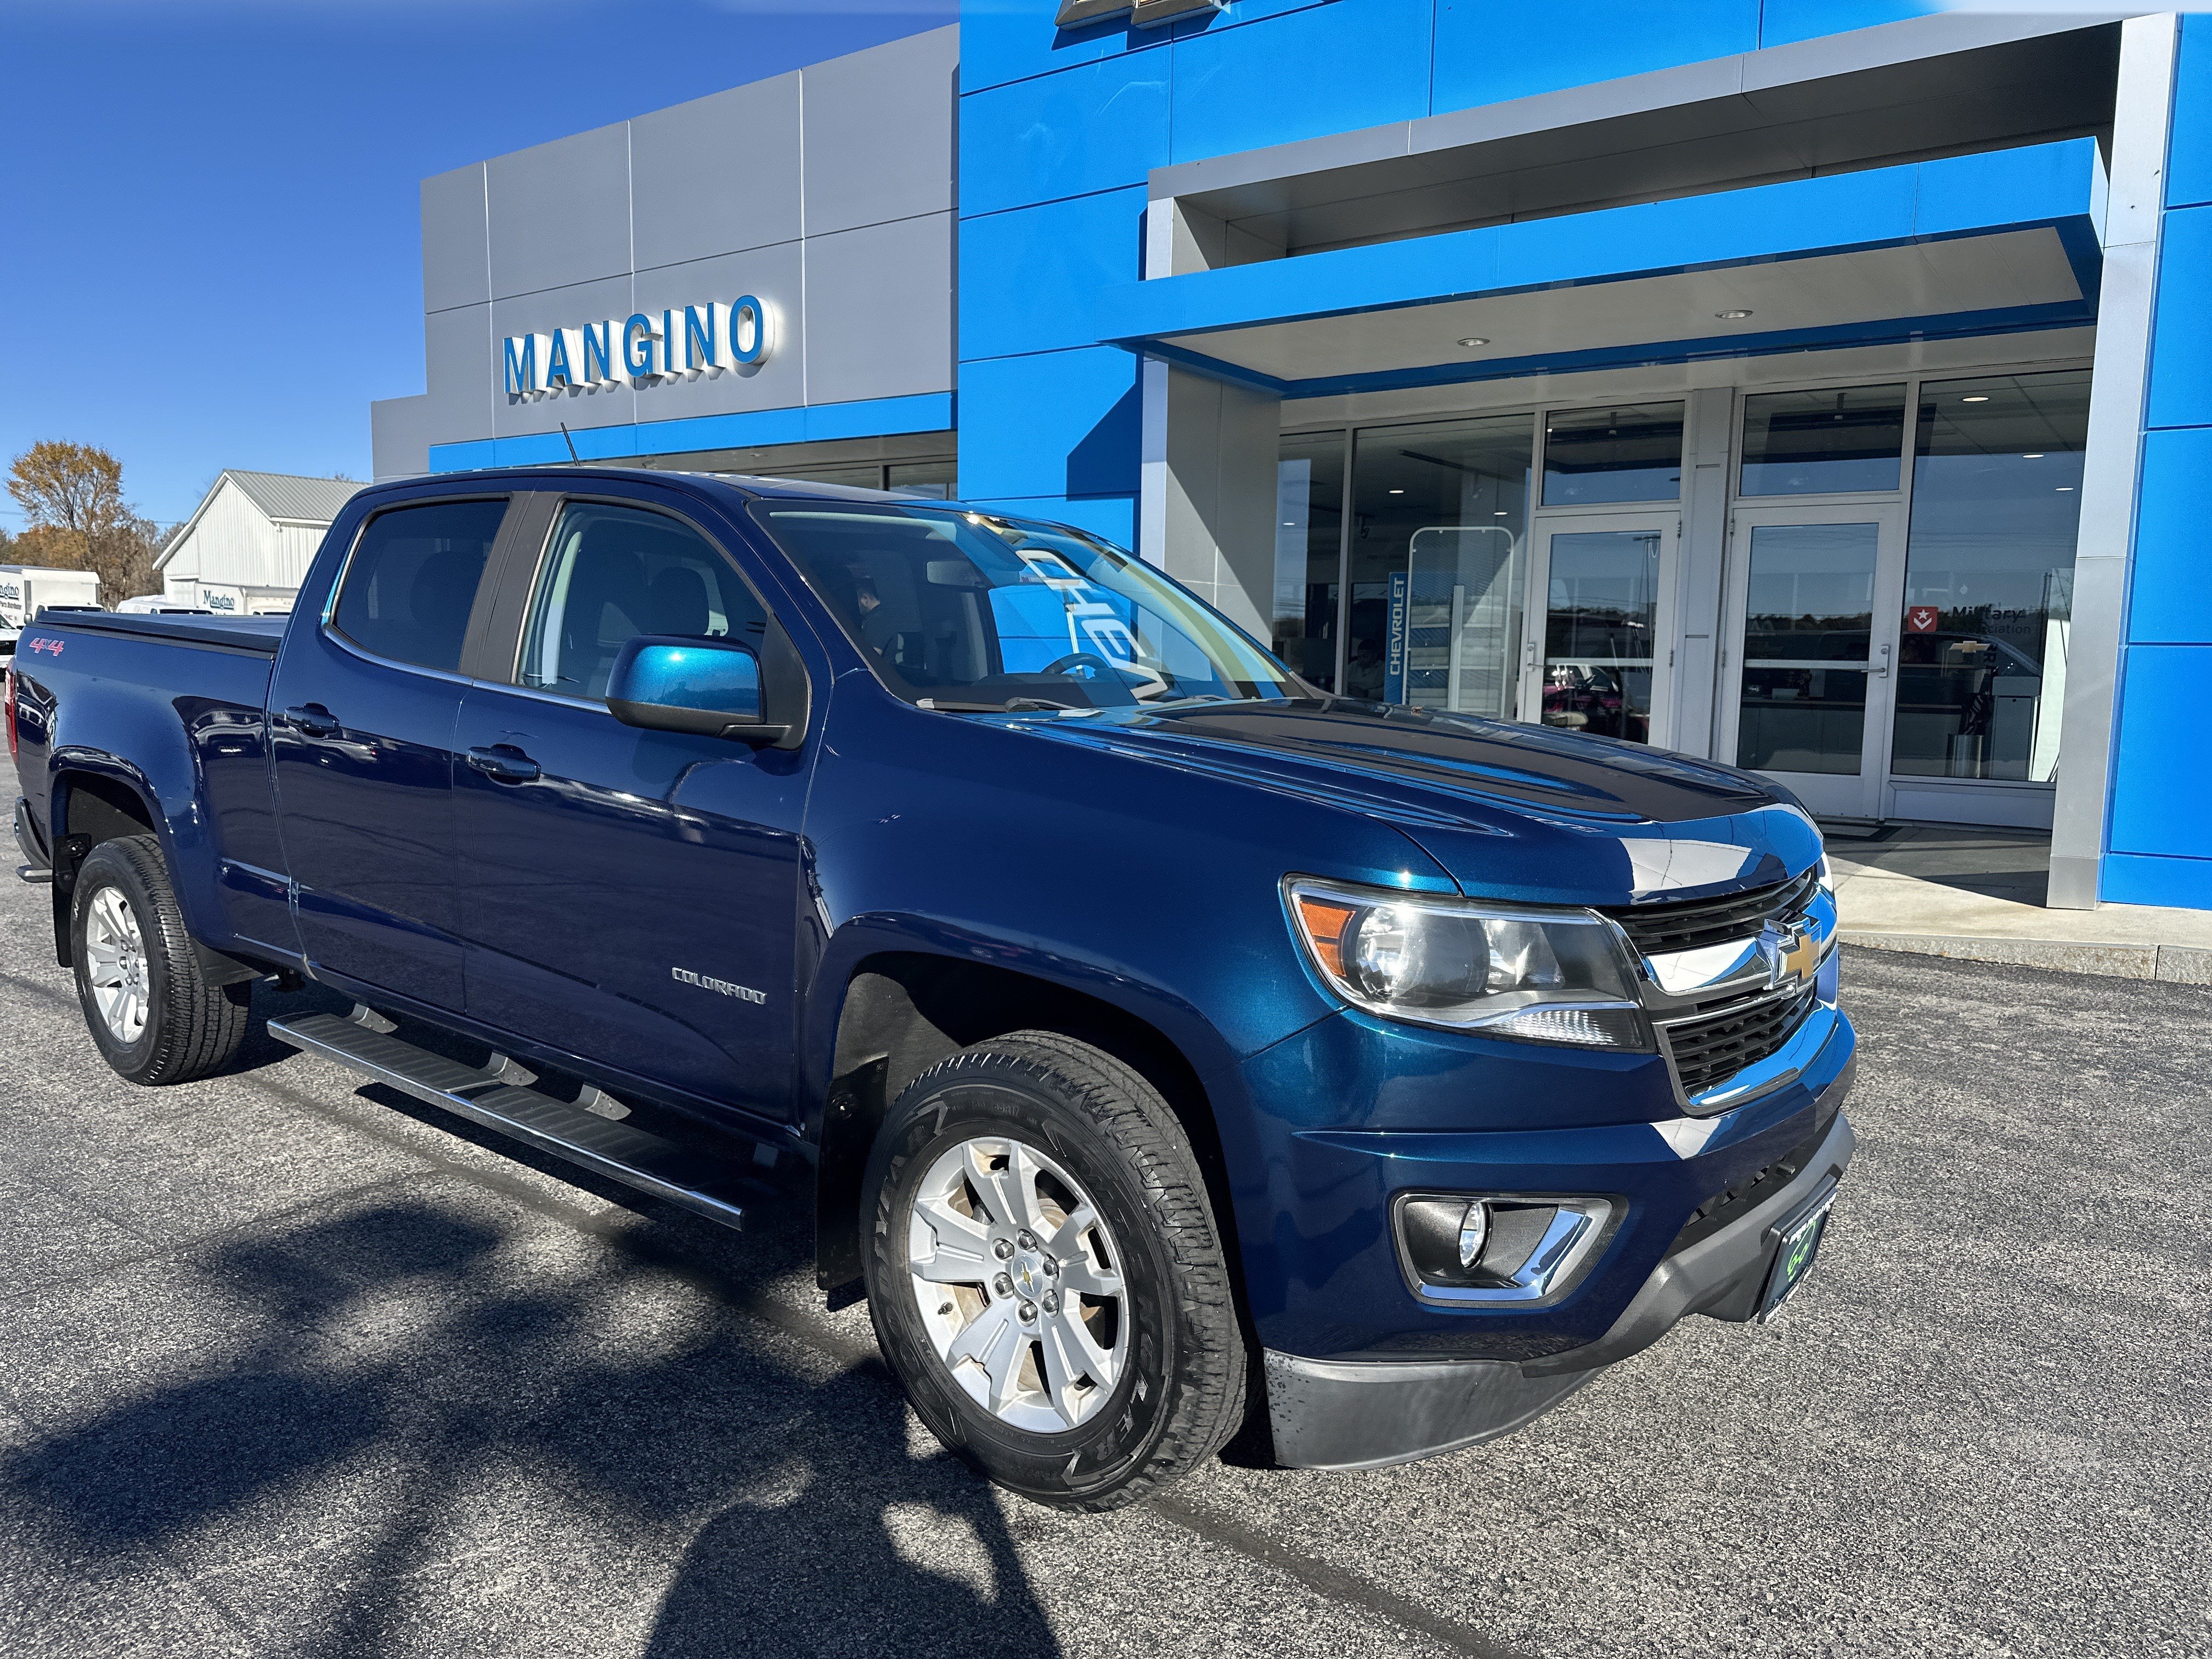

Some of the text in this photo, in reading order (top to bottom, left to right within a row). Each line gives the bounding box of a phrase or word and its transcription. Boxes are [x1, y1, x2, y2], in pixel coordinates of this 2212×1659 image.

[504, 295, 772, 394] MANGINO
[204, 590, 235, 609] Mangino
[1390, 577, 1404, 675] CHEVROLET
[1953, 606, 2024, 623] Mitary
[672, 967, 766, 1006] COLORADO
[874, 1125, 944, 1403] GOODYEAR
[1077, 1156, 1153, 1462] WRANGLER
